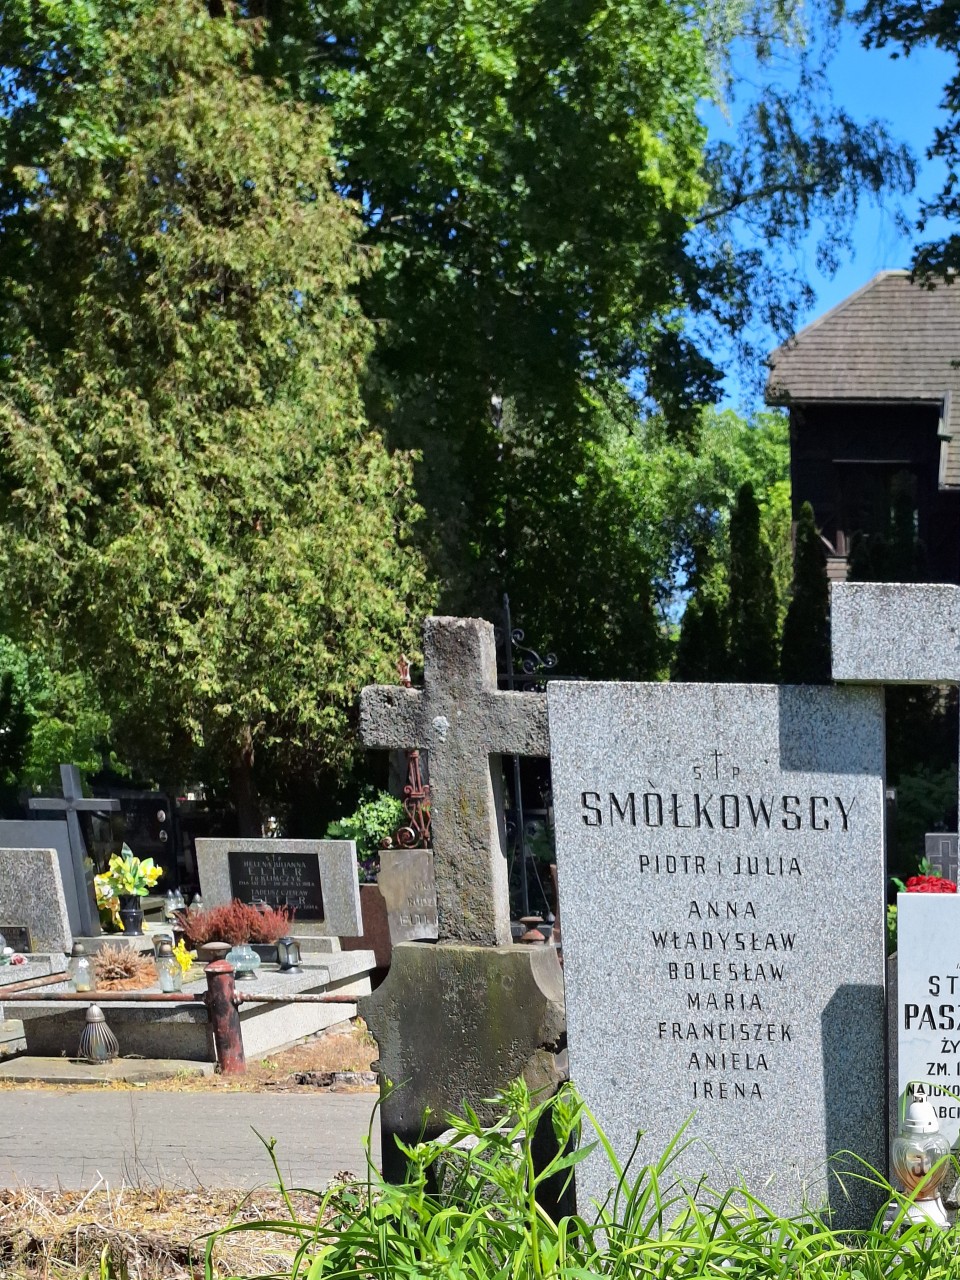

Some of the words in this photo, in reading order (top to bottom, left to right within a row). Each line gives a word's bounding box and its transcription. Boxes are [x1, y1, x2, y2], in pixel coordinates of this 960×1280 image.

[639, 854, 706, 875] PIOTR
[733, 856, 802, 876] JULIA
[688, 900, 757, 920] ANNA
[651, 931, 796, 951] WŁADYSŁAW
[668, 962, 784, 982] BOLESŁAW
[687, 992, 763, 1011] MARIA
[658, 1021, 792, 1042] FRANCISZEK
[688, 1052, 769, 1071] ANIELA
[692, 1081, 763, 1100] IRENA
